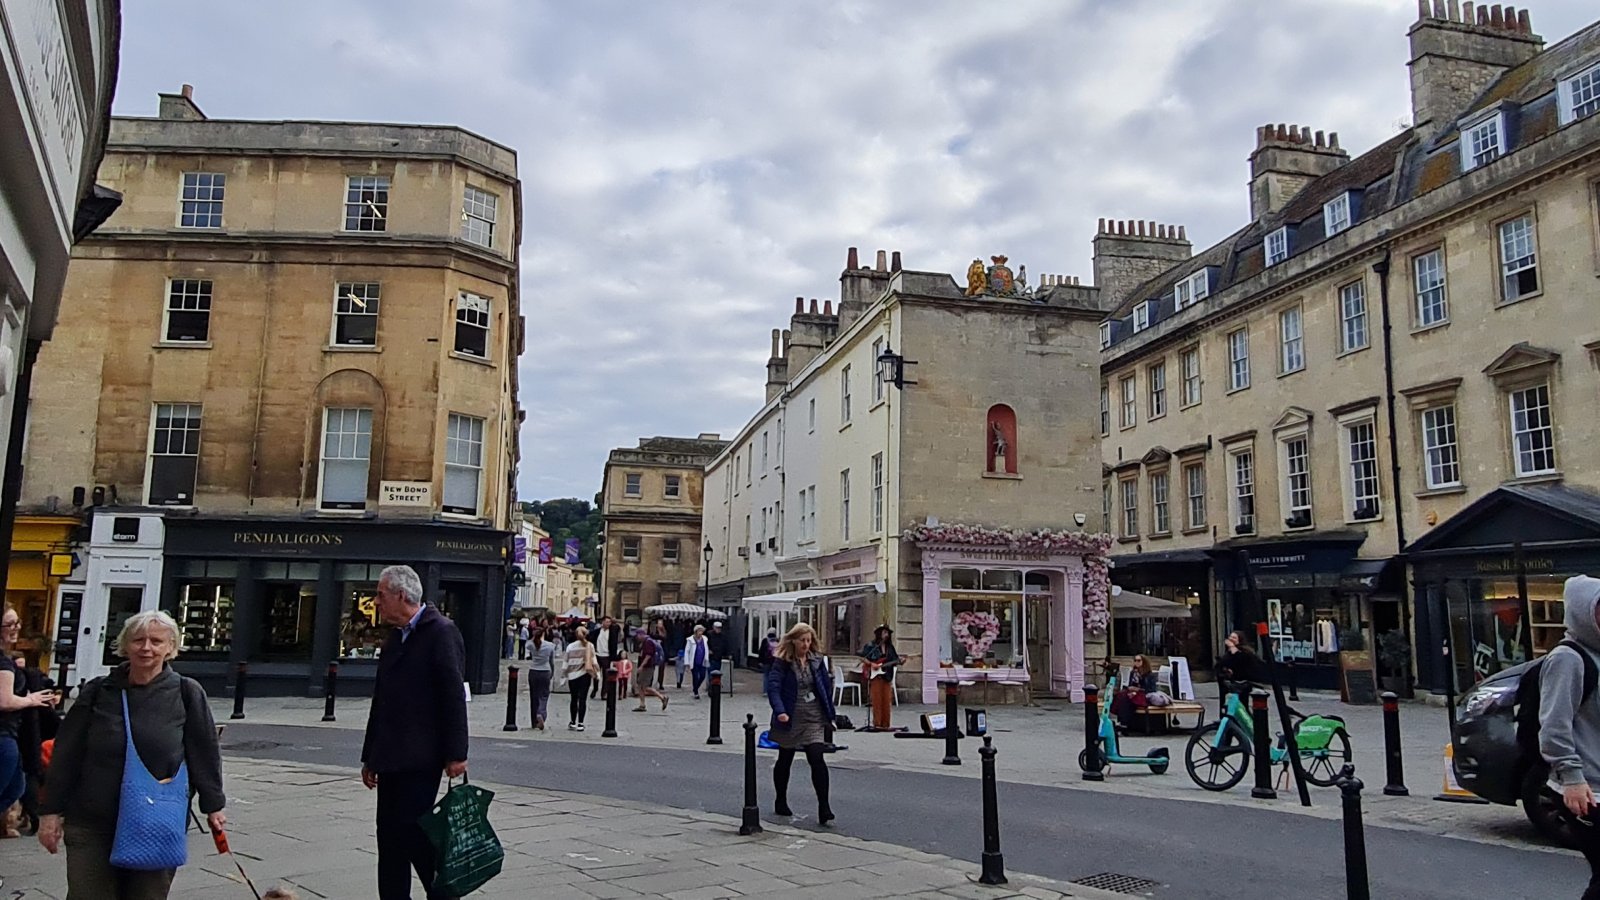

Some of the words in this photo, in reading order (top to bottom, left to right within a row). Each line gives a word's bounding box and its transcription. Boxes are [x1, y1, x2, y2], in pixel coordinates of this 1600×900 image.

[389, 494, 421, 502] STREET
[233, 532, 343, 545] PENHALIGON'S
[1524, 558, 1554, 571] omley
